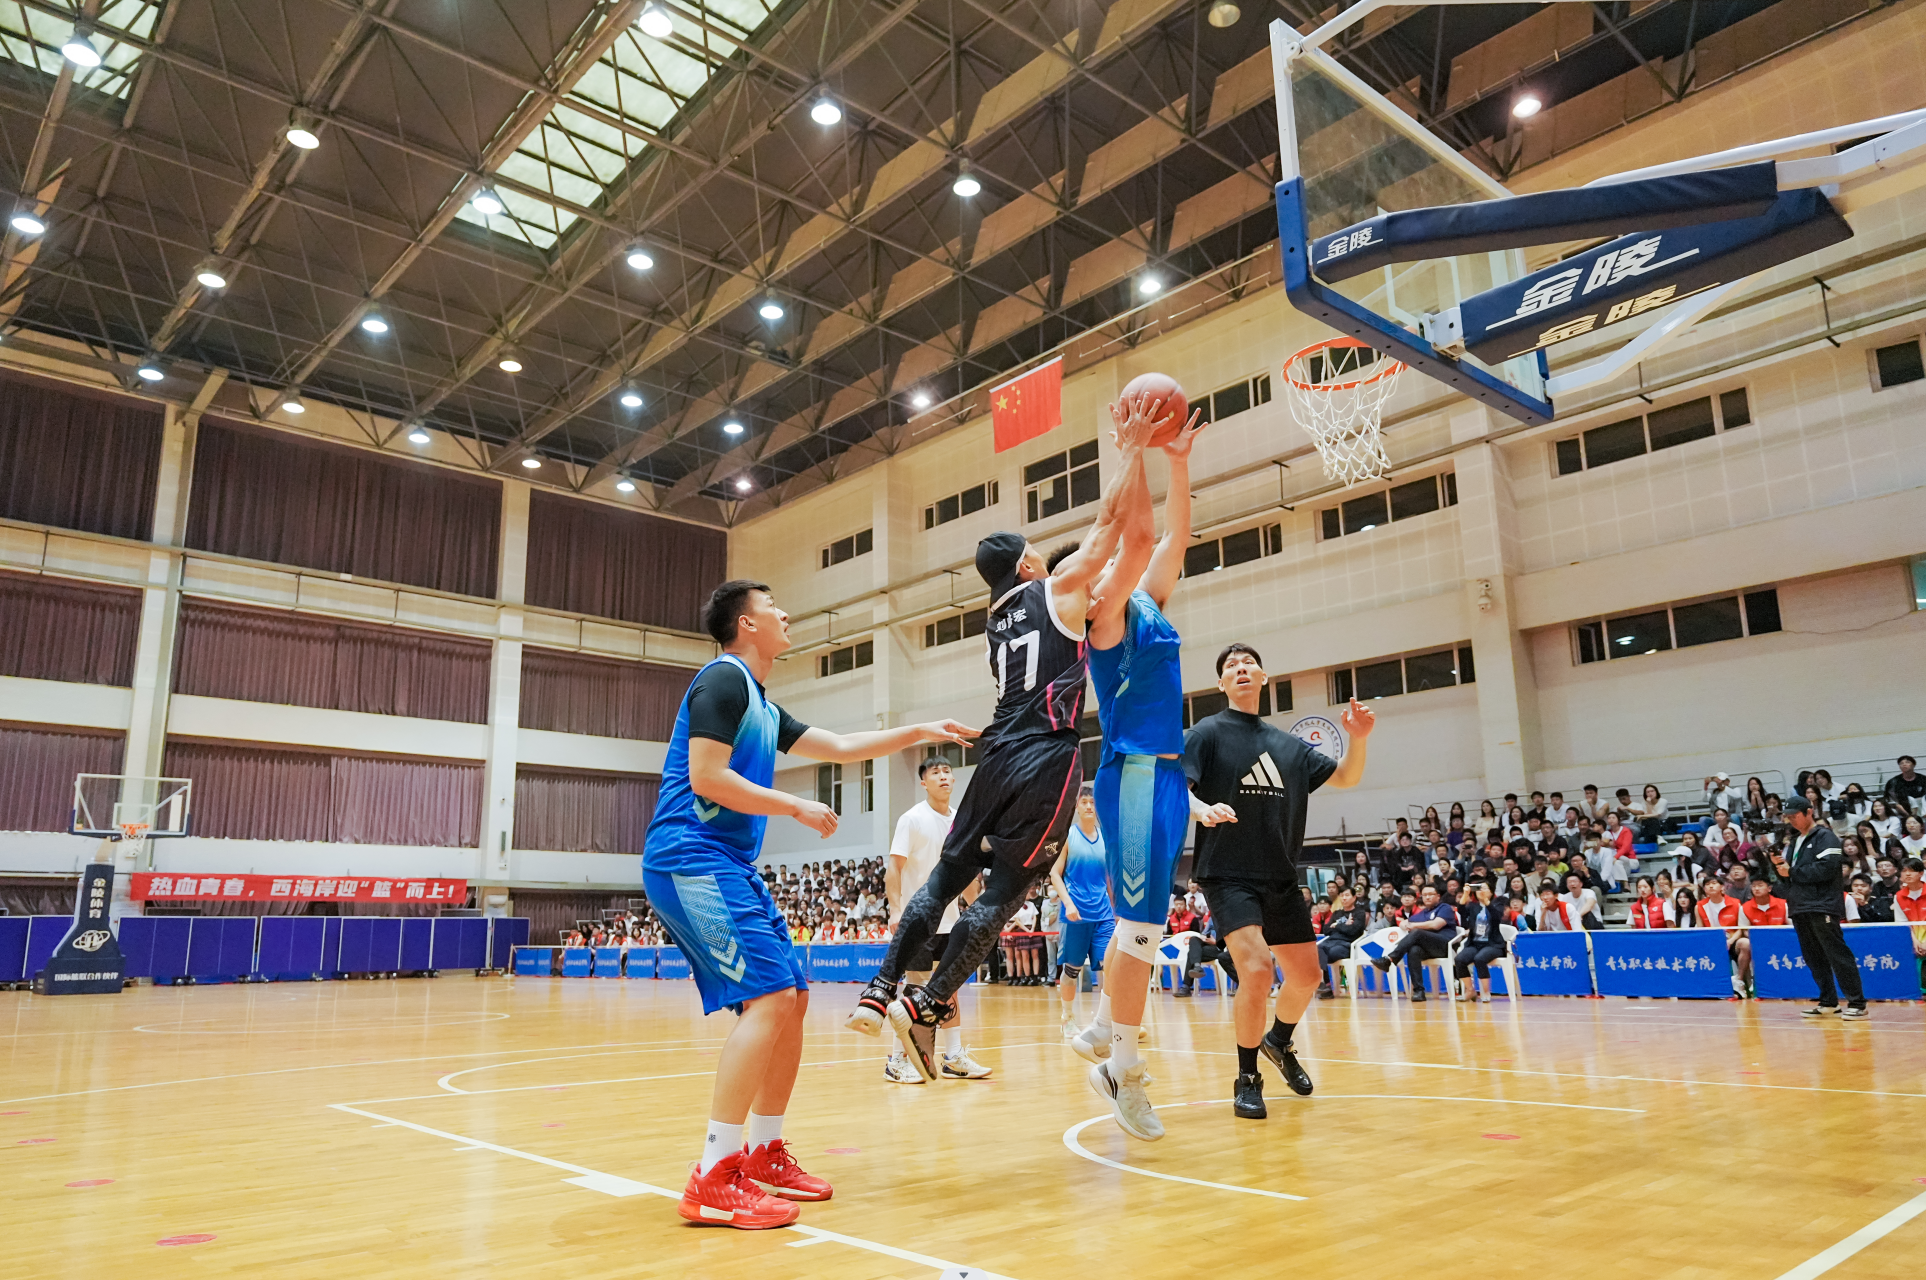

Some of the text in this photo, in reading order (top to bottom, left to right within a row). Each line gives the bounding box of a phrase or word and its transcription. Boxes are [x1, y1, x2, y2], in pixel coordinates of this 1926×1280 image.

[1327, 226, 1373, 258] 金陵
[1515, 234, 1663, 315] 金陵
[997, 629, 1041, 702] 17
